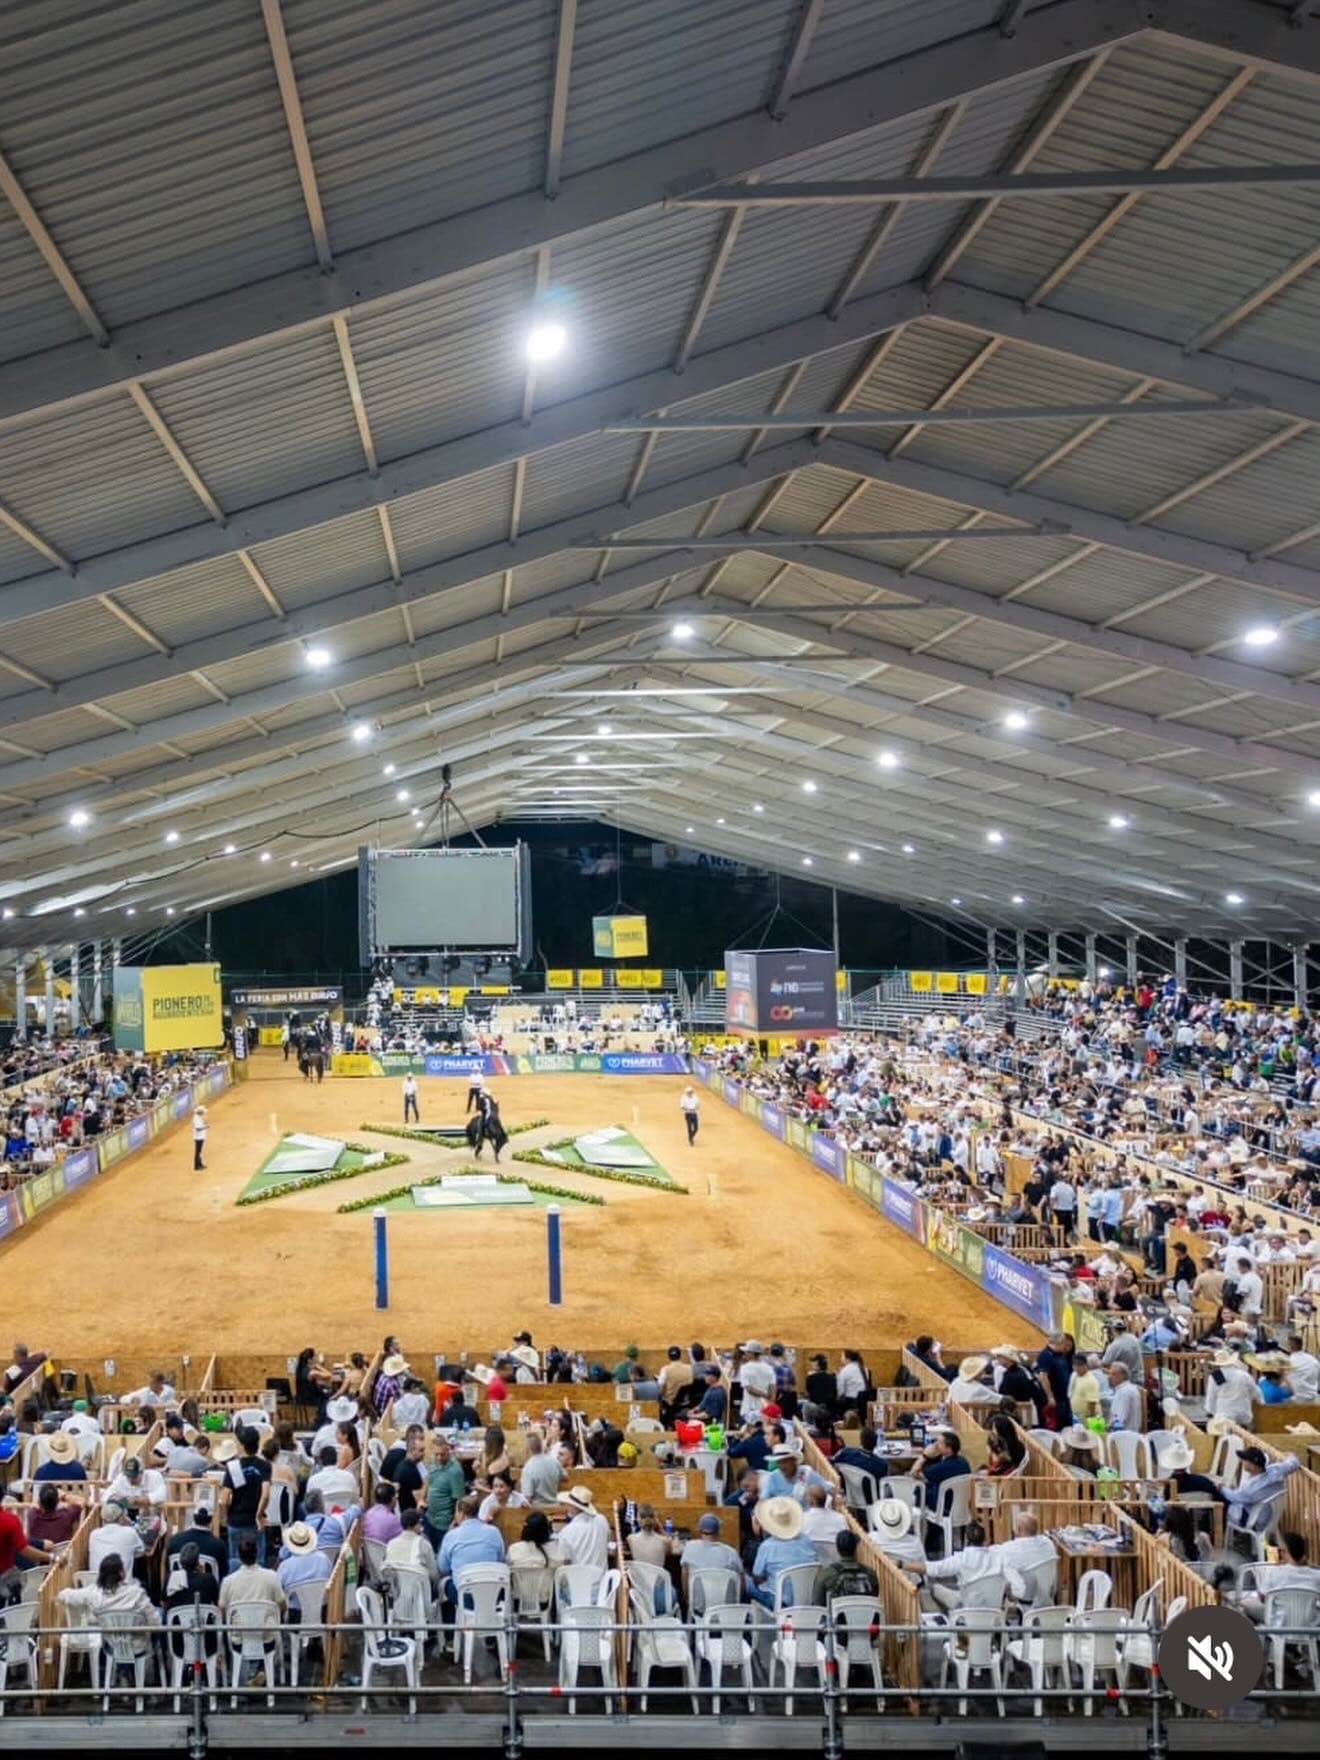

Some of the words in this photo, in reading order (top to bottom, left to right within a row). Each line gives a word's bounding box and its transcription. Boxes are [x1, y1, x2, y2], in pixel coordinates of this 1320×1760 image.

[153, 995, 202, 1011] PIONERO
[443, 1058, 486, 1070] PHARVET
[997, 1262, 1034, 1300] PHARVET
